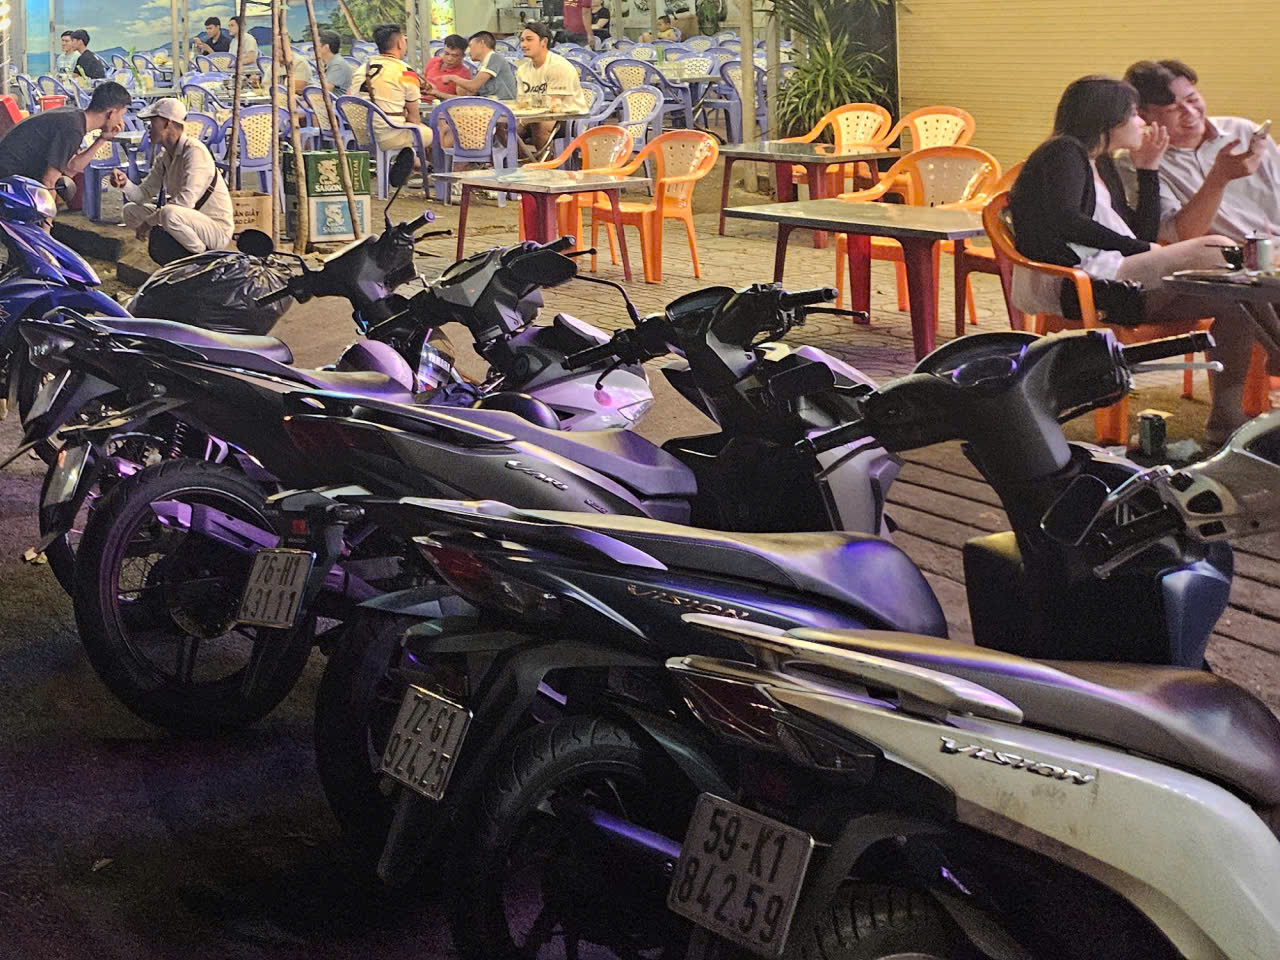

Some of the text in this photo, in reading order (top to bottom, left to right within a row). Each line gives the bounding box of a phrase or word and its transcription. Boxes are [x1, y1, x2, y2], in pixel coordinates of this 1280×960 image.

[315, 184, 343, 193] SAIGON
[941, 737, 1095, 785] VISION
[704, 808, 787, 882] 59-K1
